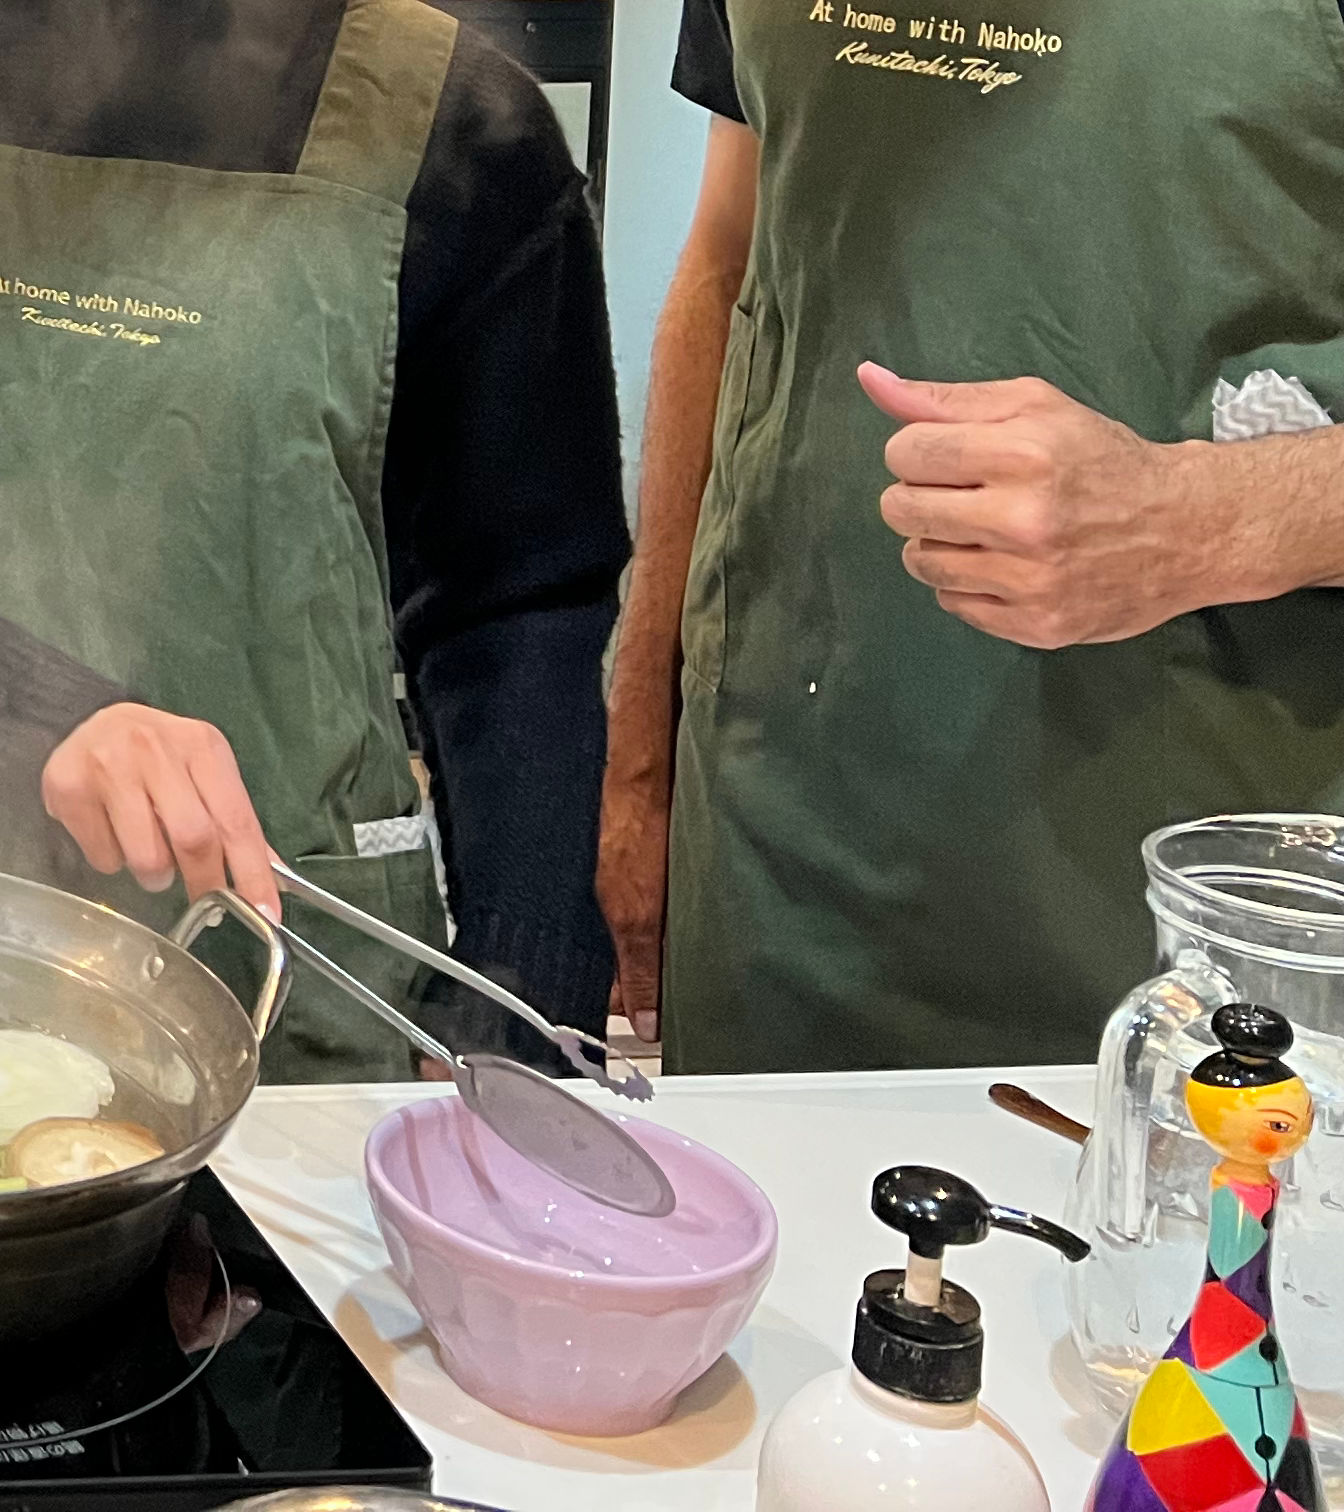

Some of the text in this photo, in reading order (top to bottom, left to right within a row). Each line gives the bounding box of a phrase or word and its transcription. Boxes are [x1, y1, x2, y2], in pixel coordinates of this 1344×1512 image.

[842, 3, 896, 33] home
[909, 16, 965, 45] with
[977, 22, 1062, 57] Nahoko
[958, 57, 1023, 94] Tokyo
[14, 277, 71, 306] home
[75, 293, 119, 313] with
[123, 297, 202, 325] Nahoko
